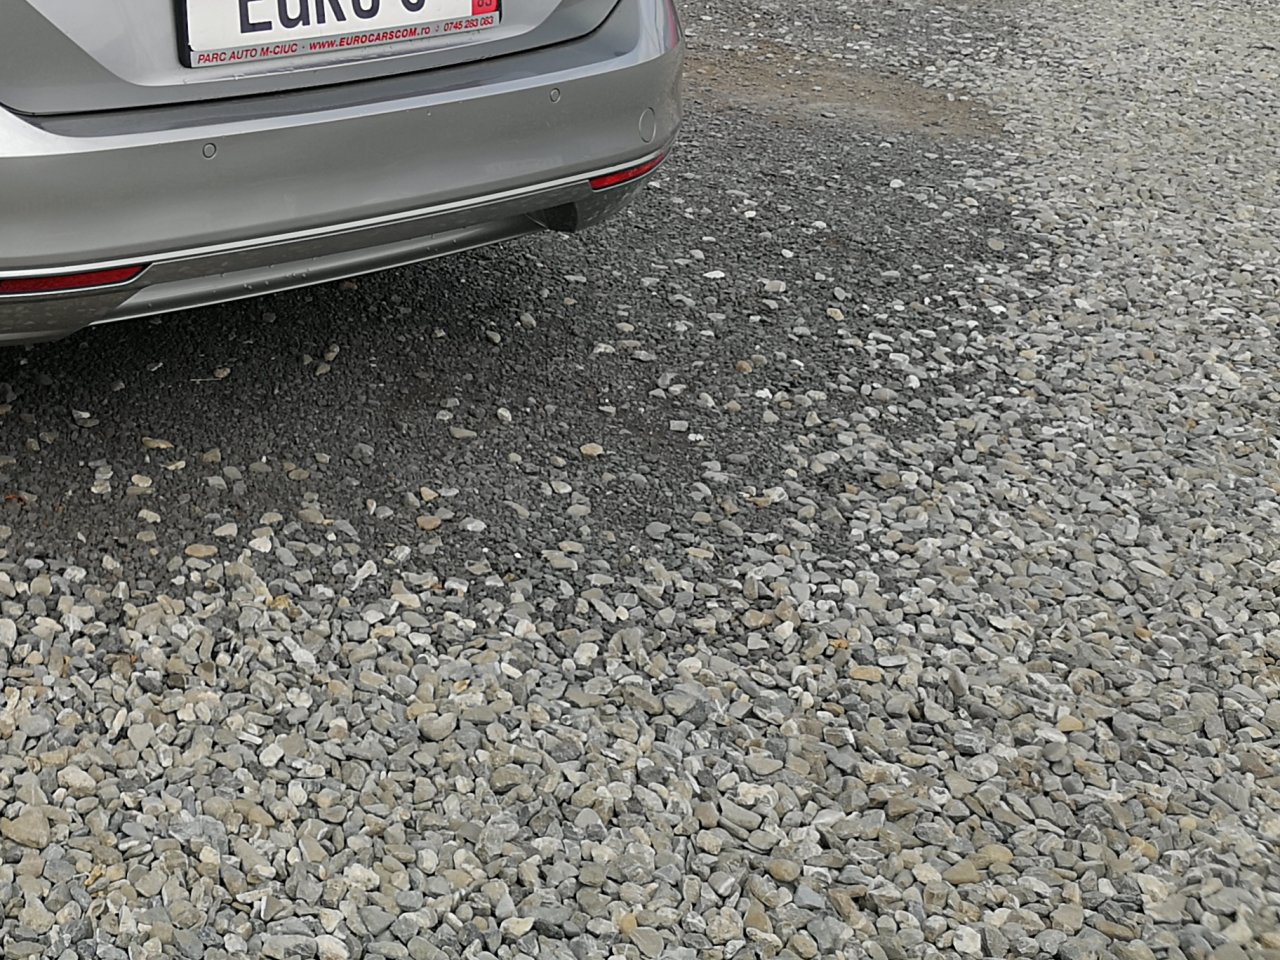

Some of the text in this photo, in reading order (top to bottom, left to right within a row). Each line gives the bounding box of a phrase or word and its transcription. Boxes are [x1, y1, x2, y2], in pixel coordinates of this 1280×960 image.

[198, 52, 227, 64] PARC
[229, 48, 258, 60] AUTO
[259, 43, 298, 56] M-CIUC
[443, 20, 463, 32] 0745
